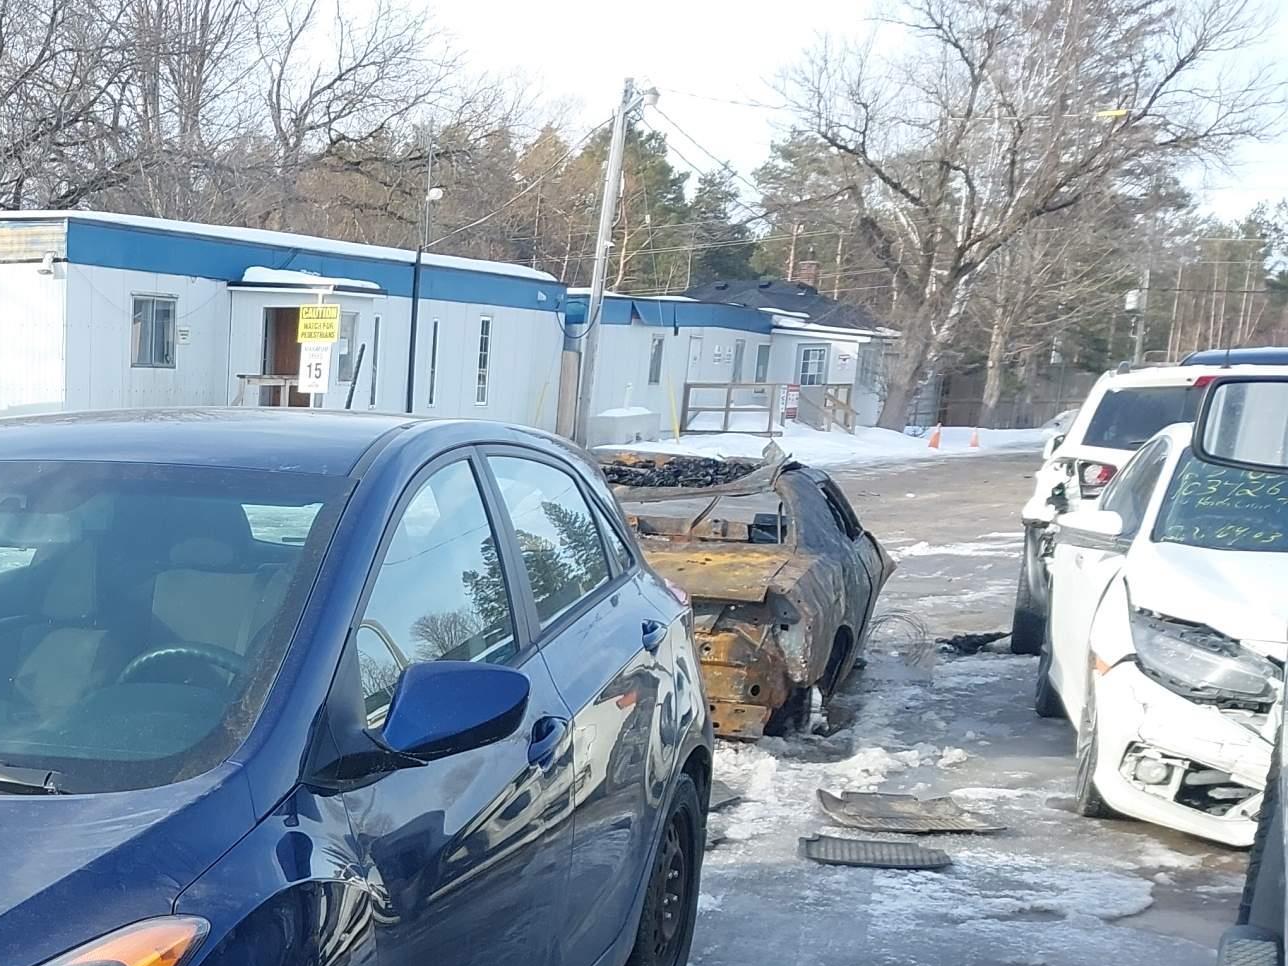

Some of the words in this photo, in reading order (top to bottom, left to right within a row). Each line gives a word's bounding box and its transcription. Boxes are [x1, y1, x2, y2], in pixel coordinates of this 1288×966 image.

[302, 307, 337, 319] CAUTION
[303, 322, 321, 330] WATCH
[322, 322, 334, 330] FOR
[300, 331, 335, 339] PEDESTRIANS
[306, 362, 323, 379] 15
